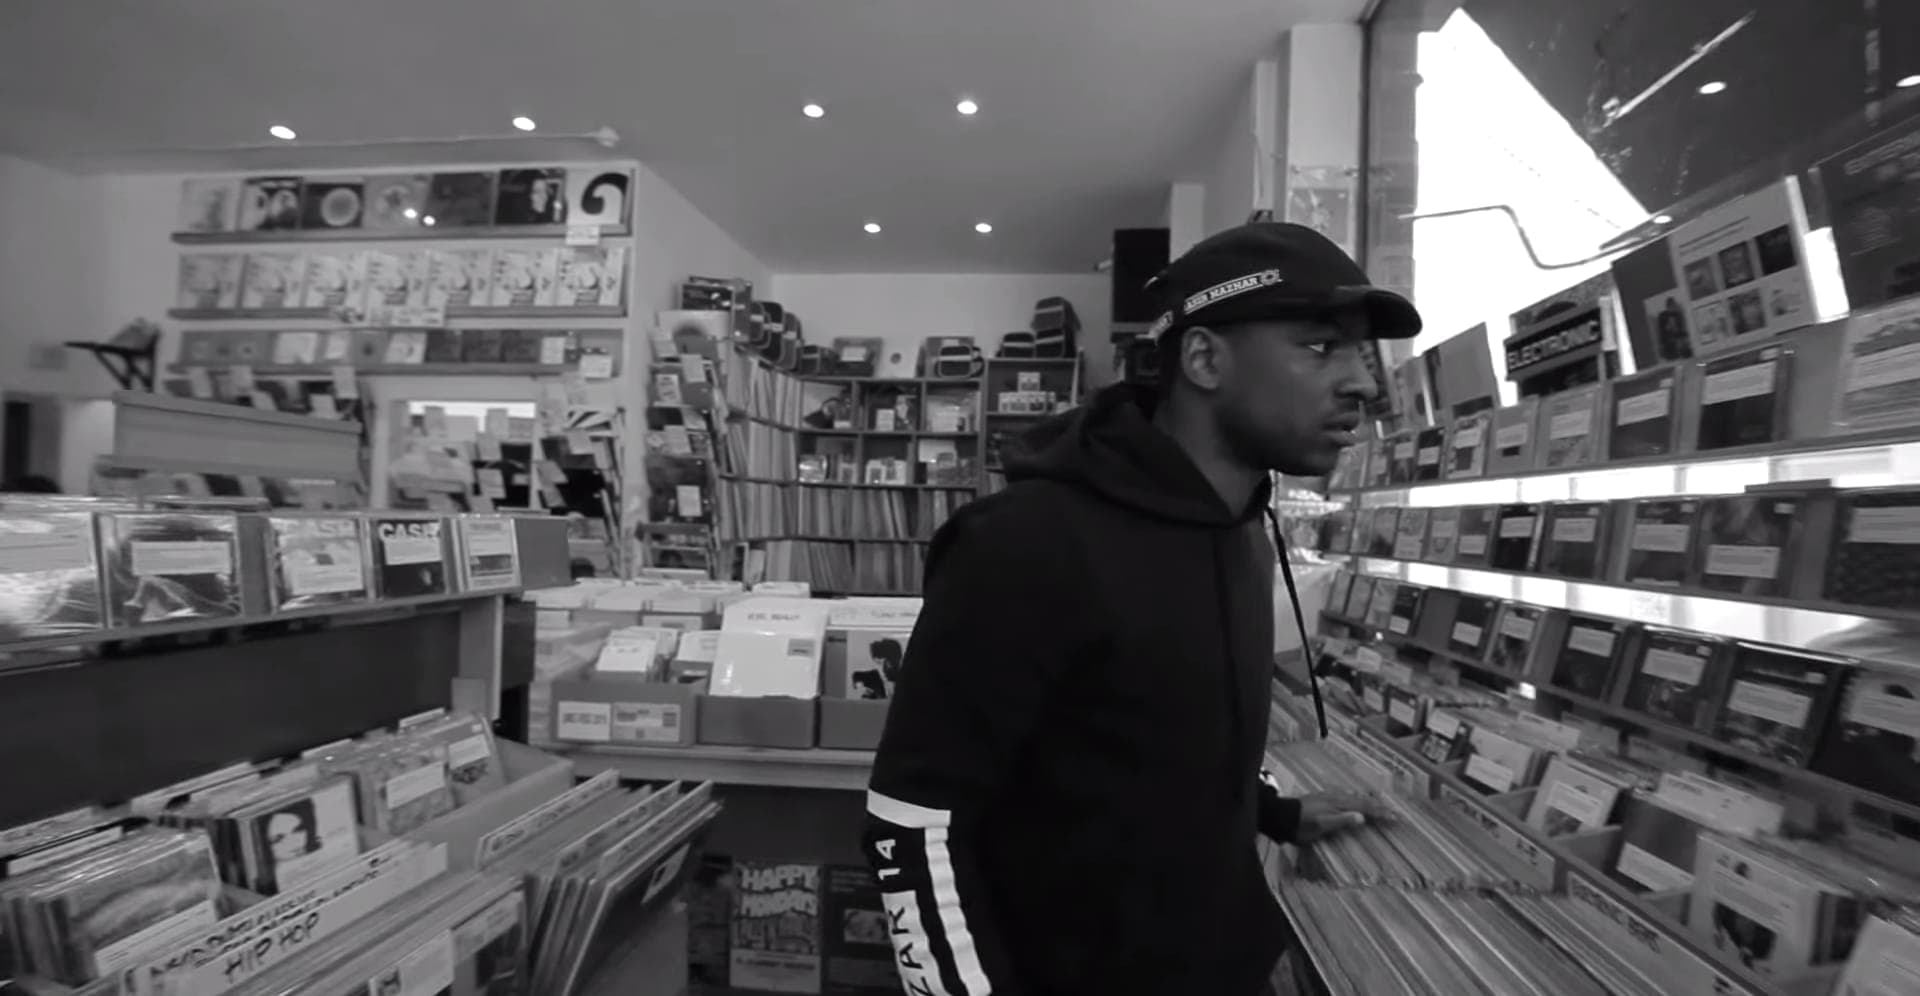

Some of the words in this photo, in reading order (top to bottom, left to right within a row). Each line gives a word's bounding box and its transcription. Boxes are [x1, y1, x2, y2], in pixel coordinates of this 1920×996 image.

[1507, 321, 1598, 369] ELECTRONIC
[379, 522, 440, 540] CASH
[875, 839, 900, 881] 14
[741, 865, 819, 890] HAPPY
[740, 889, 818, 916] MONDAYS
[225, 937, 273, 984] HIP
[279, 912, 319, 947] HOP
